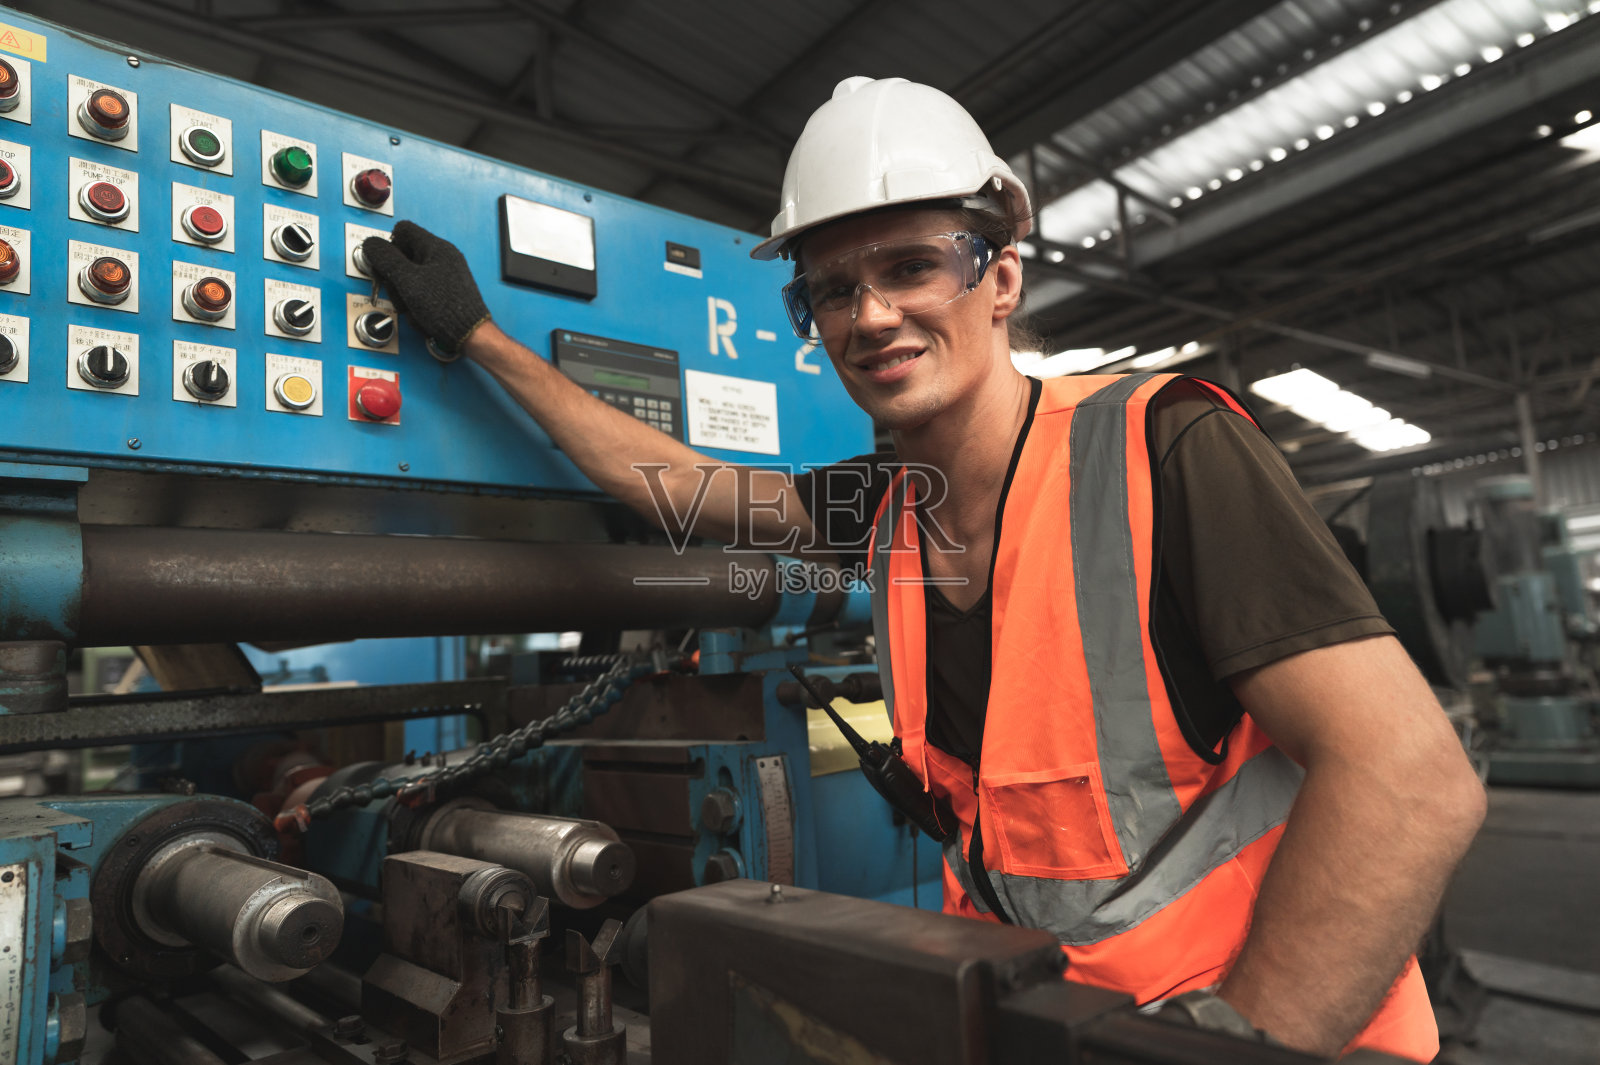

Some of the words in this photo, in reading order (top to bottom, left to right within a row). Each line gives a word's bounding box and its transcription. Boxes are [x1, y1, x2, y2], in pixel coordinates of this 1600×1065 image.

[83, 169, 103, 180] PUMP
[106, 175, 126, 185] STOP
[707, 296, 738, 359] R
